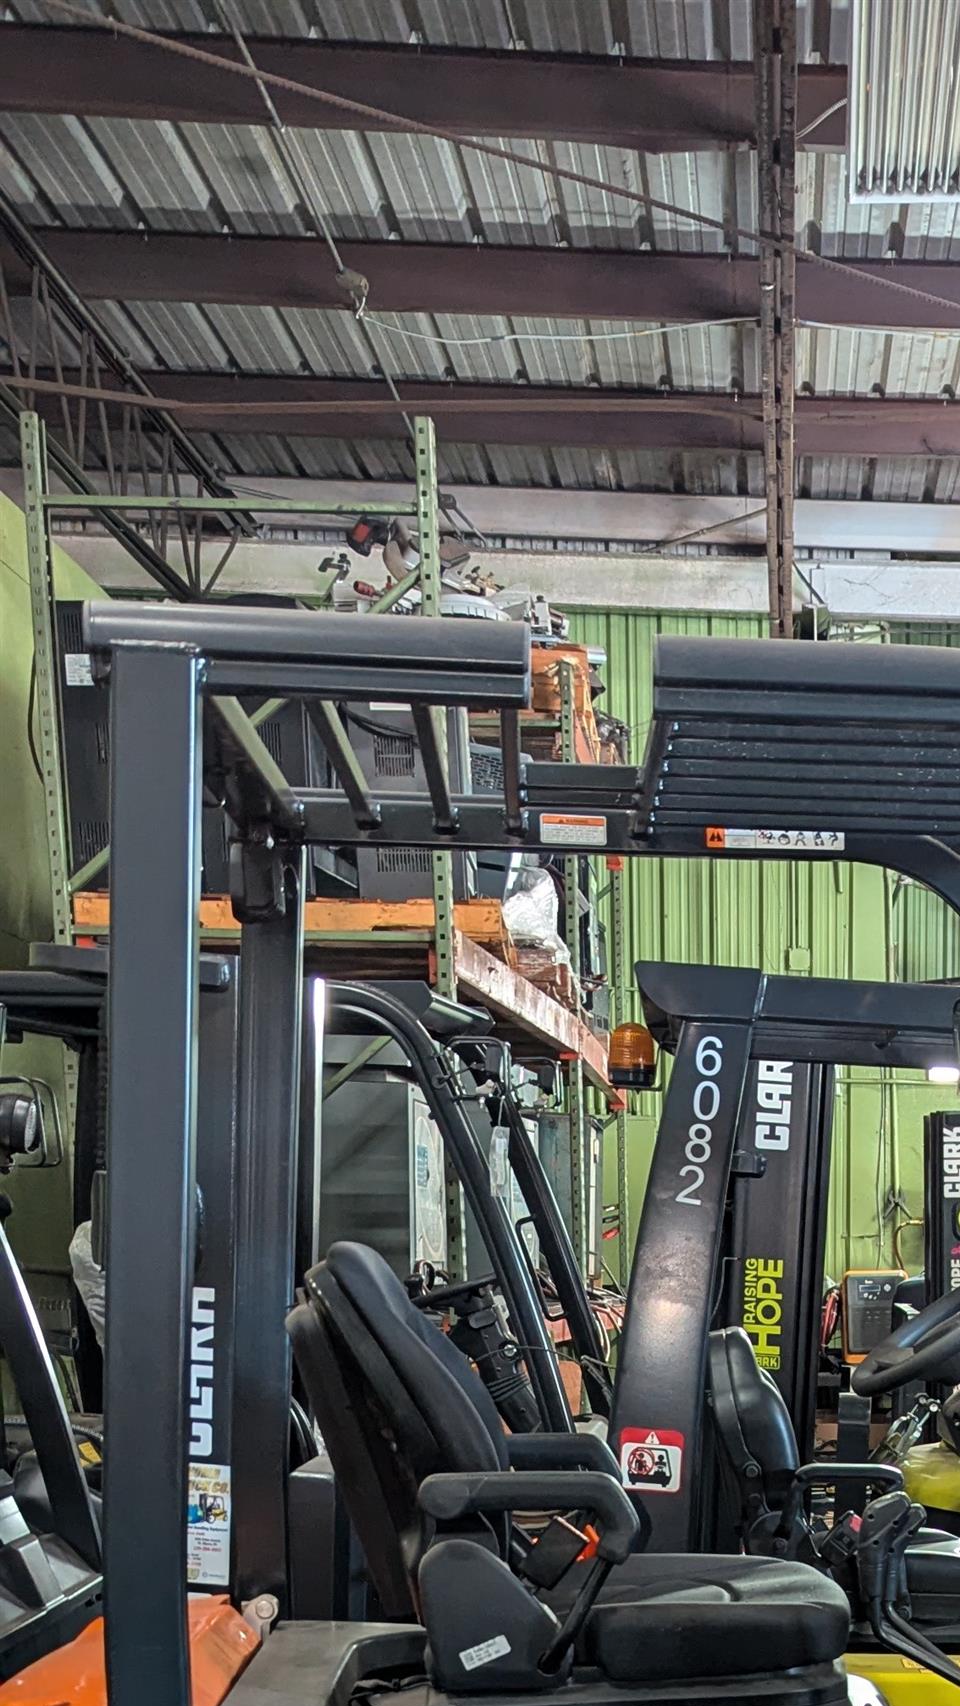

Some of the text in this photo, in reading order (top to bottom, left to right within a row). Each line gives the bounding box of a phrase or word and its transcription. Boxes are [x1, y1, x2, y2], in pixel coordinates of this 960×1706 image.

[675, 1036, 723, 1206] 6082
[755, 1060, 794, 1151] CLAR
[743, 1258, 758, 1323] RAISING
[743, 1259, 784, 1355] HOPE
